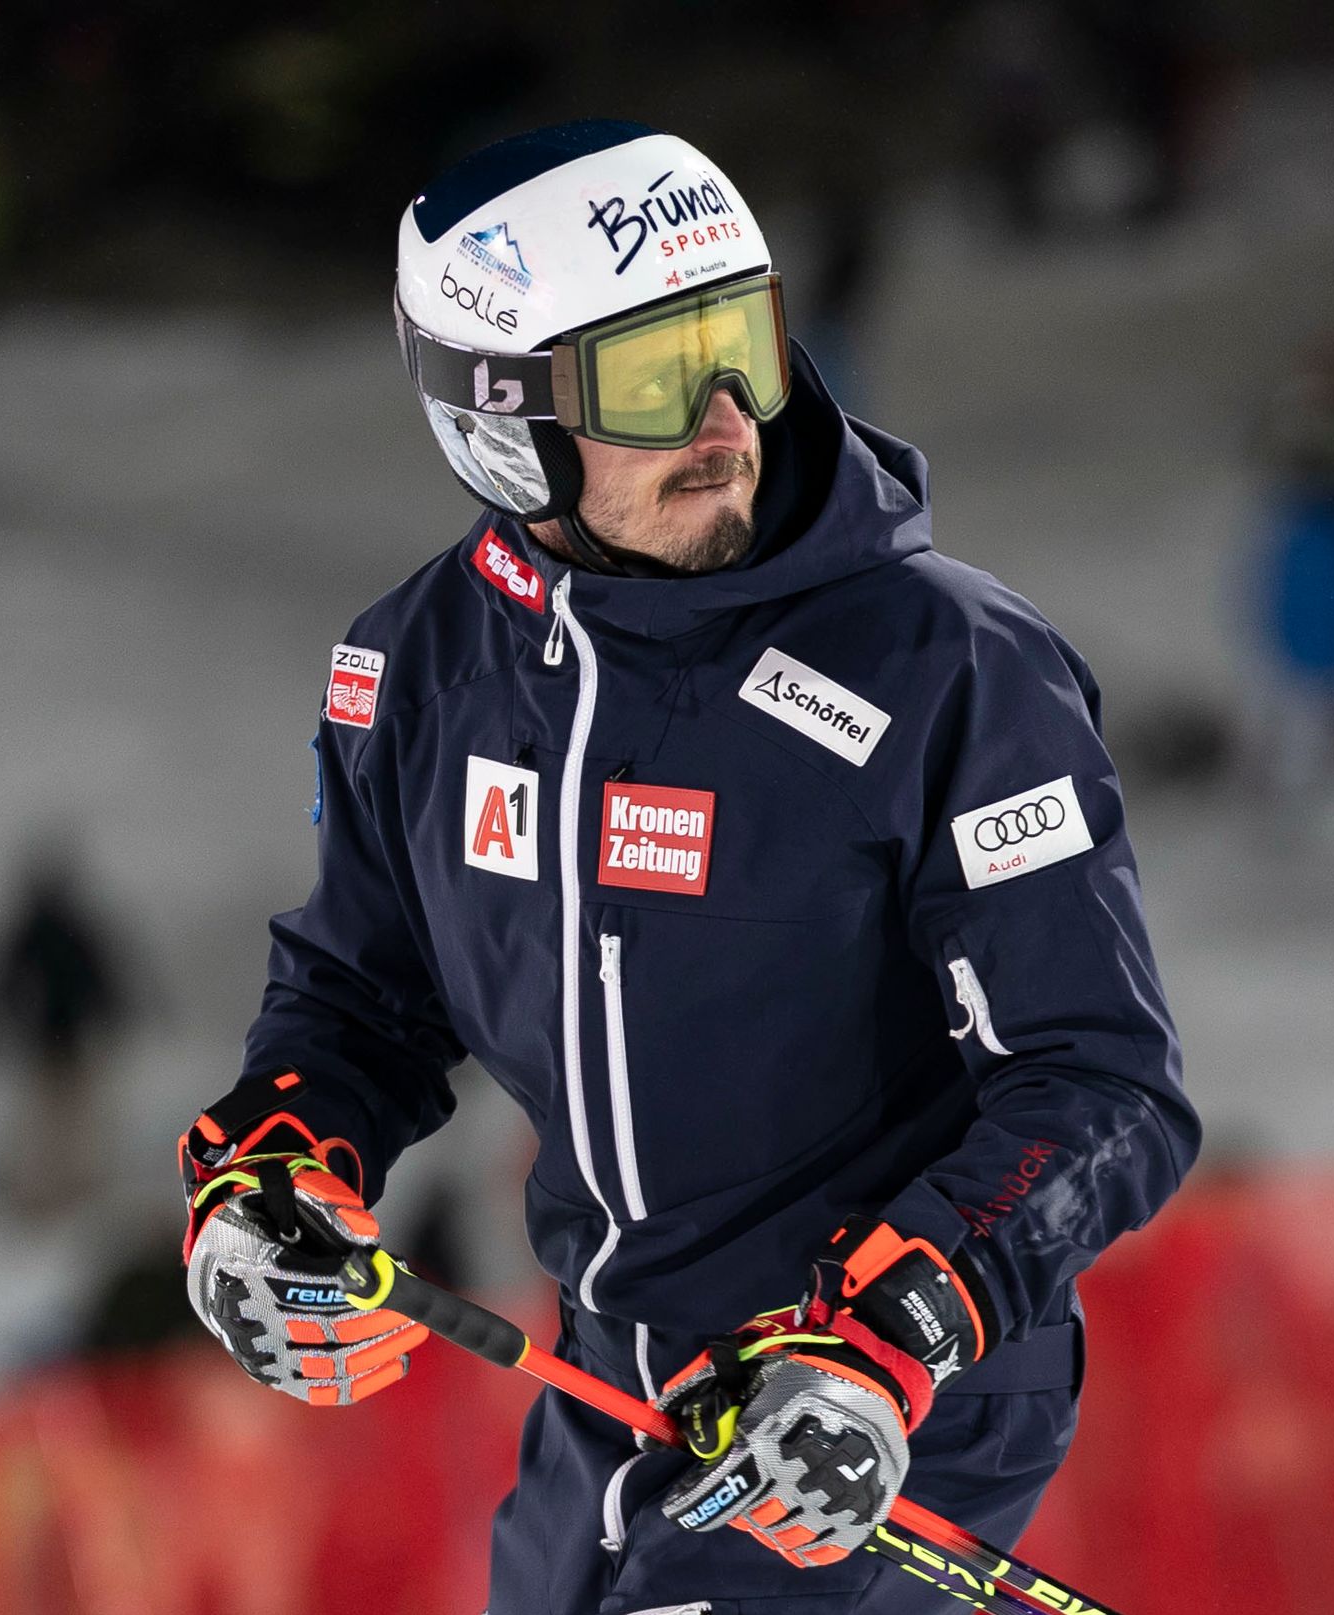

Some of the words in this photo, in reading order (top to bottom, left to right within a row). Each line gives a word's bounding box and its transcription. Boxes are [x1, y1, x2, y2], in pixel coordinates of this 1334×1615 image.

[661, 222, 741, 257] SPORTS
[684, 268, 698, 279] Ski
[700, 261, 727, 274] Austria
[486, 541, 539, 599] Tirol
[336, 651, 379, 672] ZOLL
[472, 783, 527, 859] A1
[609, 795, 705, 839] Kronen
[606, 834, 702, 881] Zeitung
[987, 854, 1027, 875] Audi
[286, 1287, 348, 1304] reus
[677, 1474, 749, 1529] reusch
